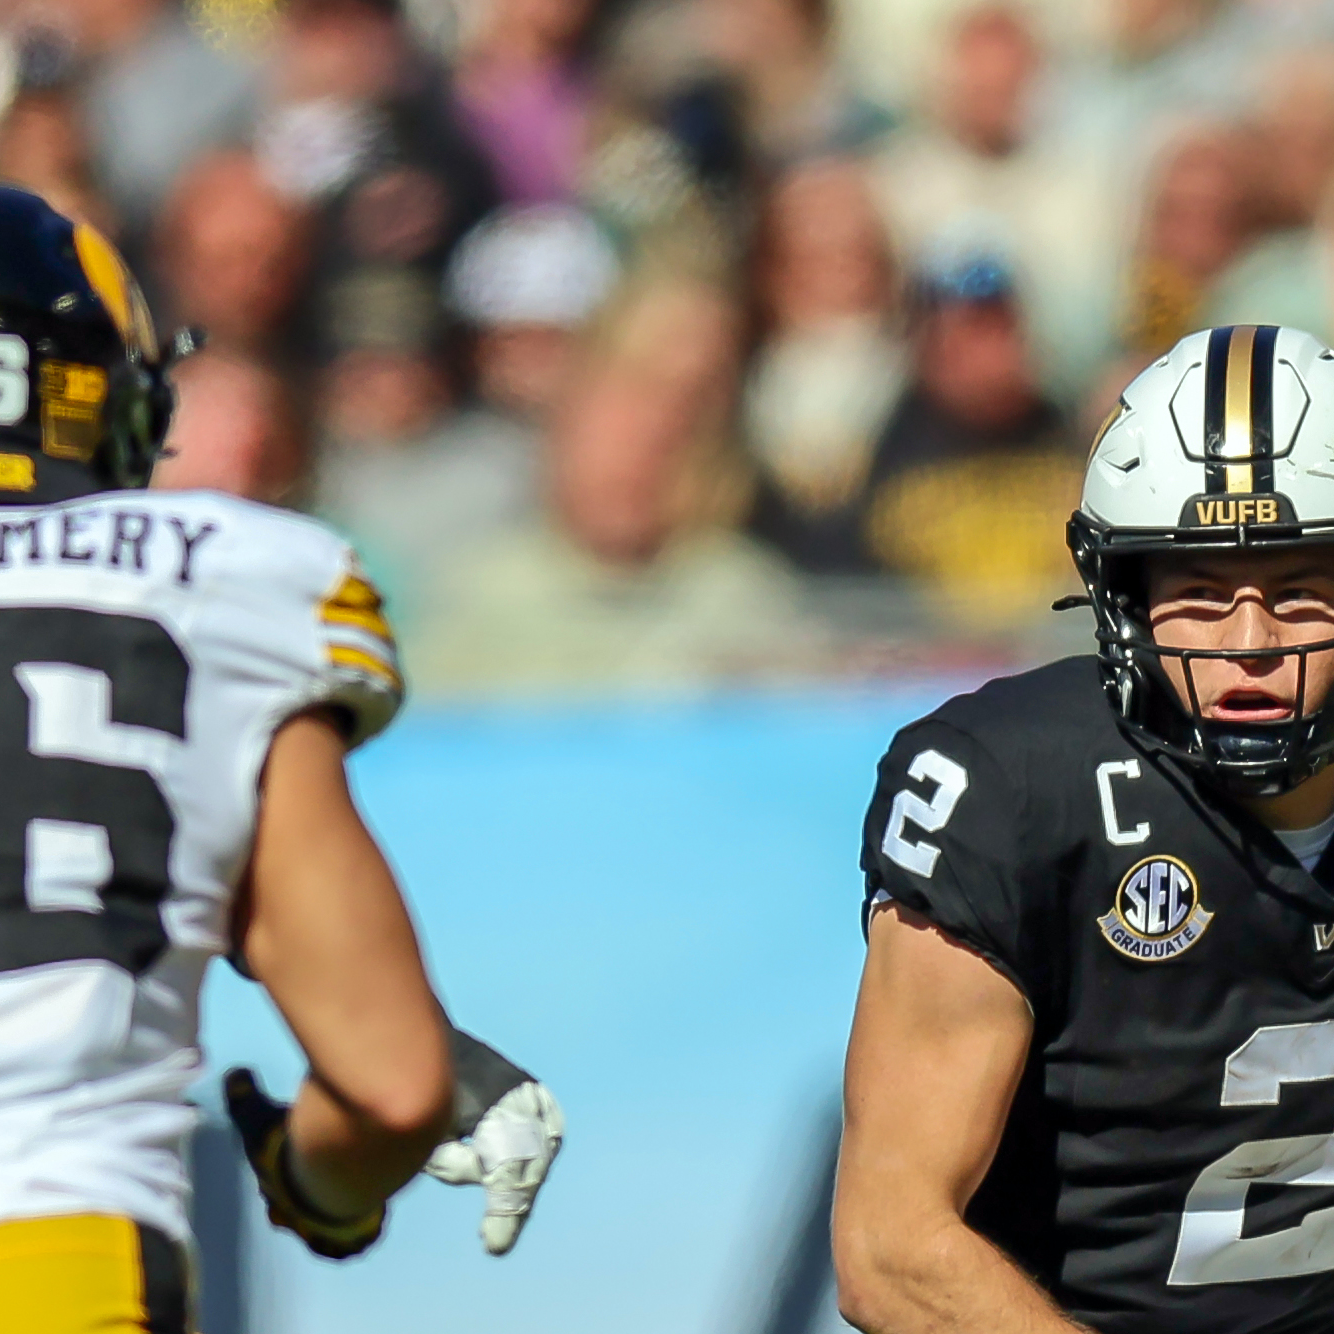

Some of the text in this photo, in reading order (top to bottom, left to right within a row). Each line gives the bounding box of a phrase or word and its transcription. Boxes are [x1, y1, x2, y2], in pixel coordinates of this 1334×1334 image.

[1196, 499, 1279, 525] VUFB
[880, 749, 969, 879] 2
[1096, 758, 1151, 847] C
[1124, 861, 1190, 934] SEC
[1110, 926, 1196, 958] GRADUATE
